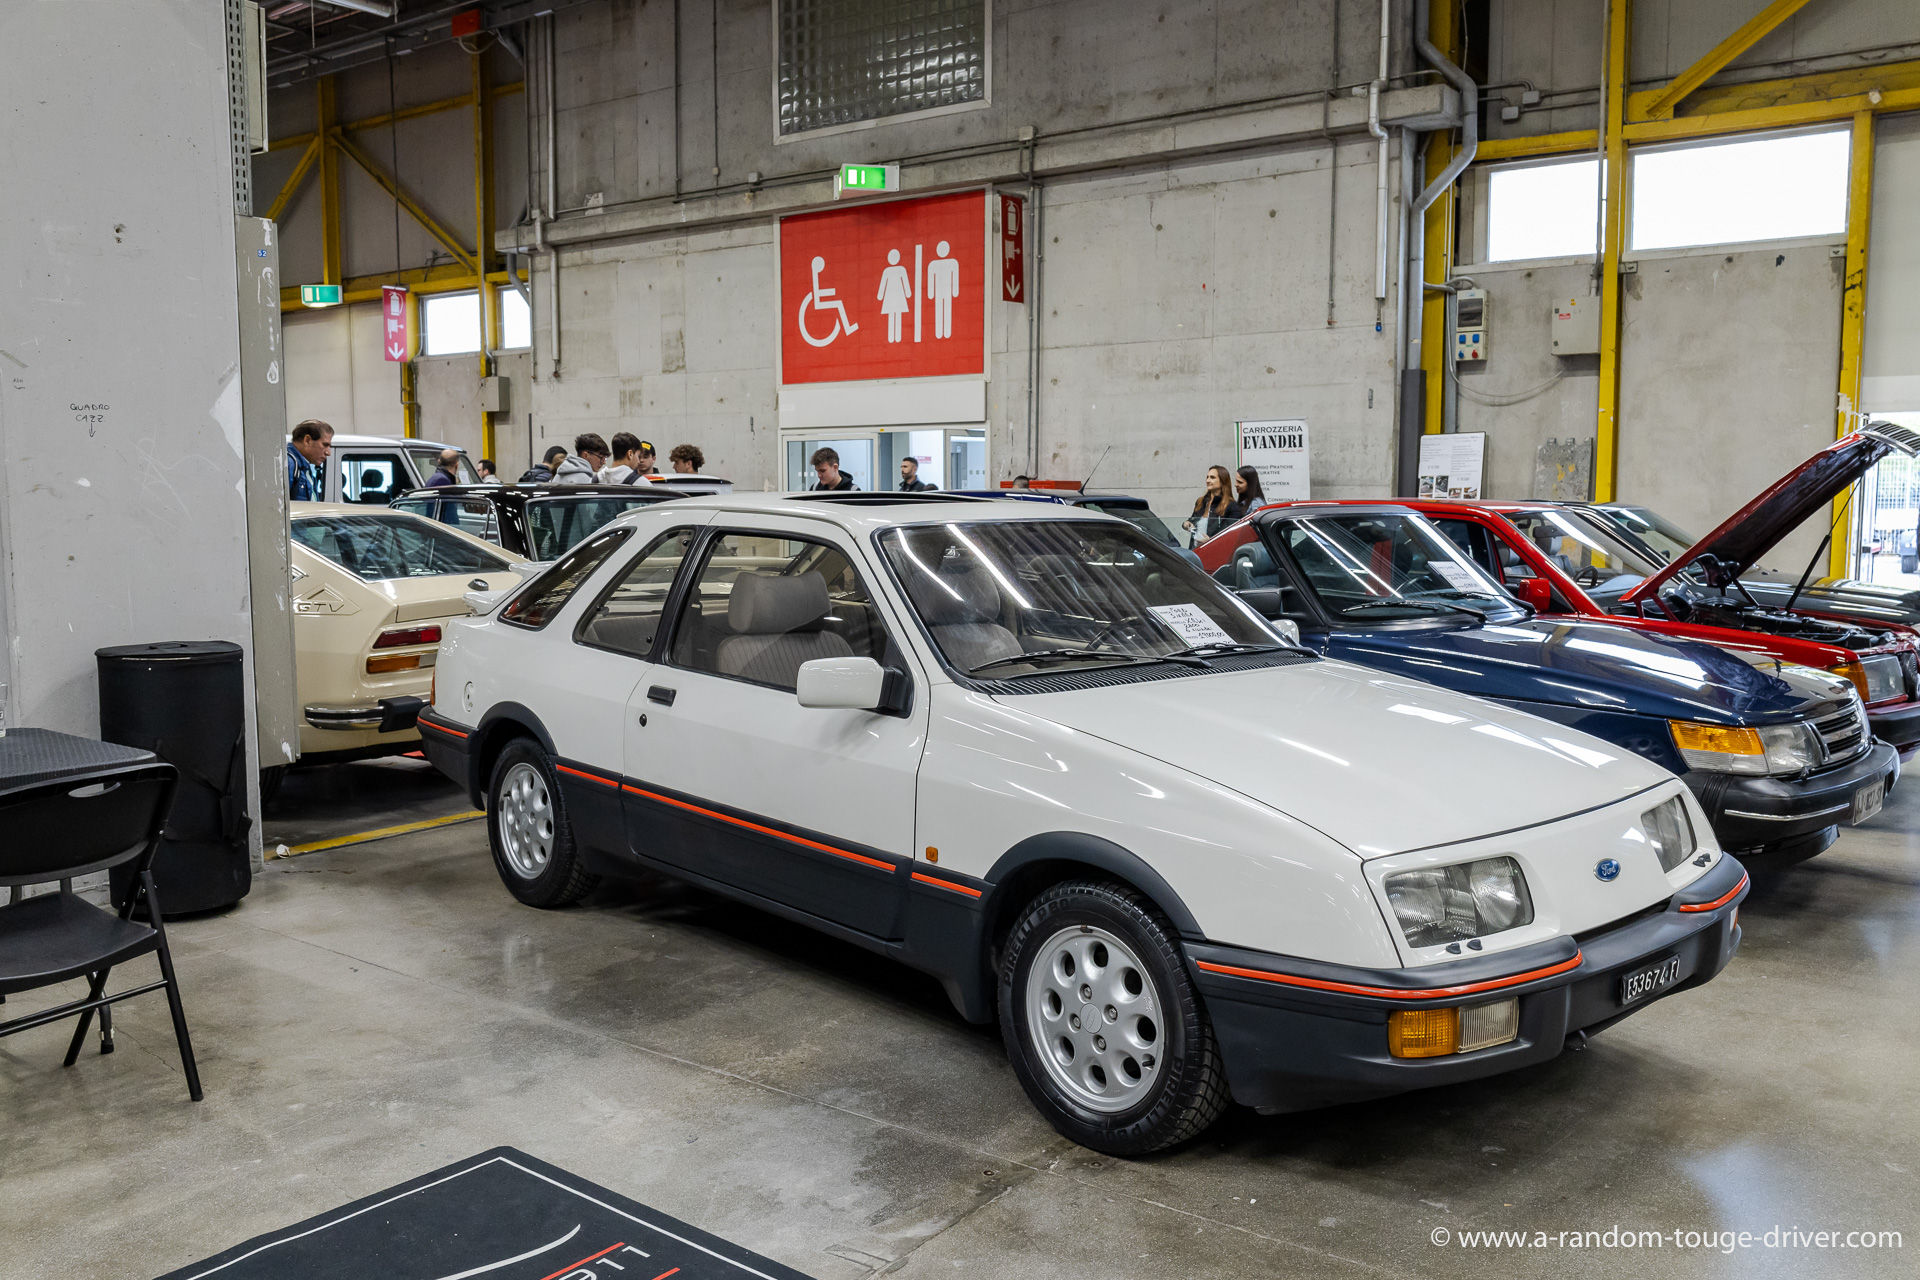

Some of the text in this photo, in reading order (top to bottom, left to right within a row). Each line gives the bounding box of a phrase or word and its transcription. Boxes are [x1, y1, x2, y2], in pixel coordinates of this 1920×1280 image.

[1243, 425, 1303, 434] CARROZZERIA
[1243, 434, 1303, 449] EVANDRI
[298, 602, 345, 612] GTV
[1003, 919, 1034, 987] PIRELLI
[1627, 966, 1666, 1000] E53674
[1146, 1056, 1183, 1127] PIRELLI
